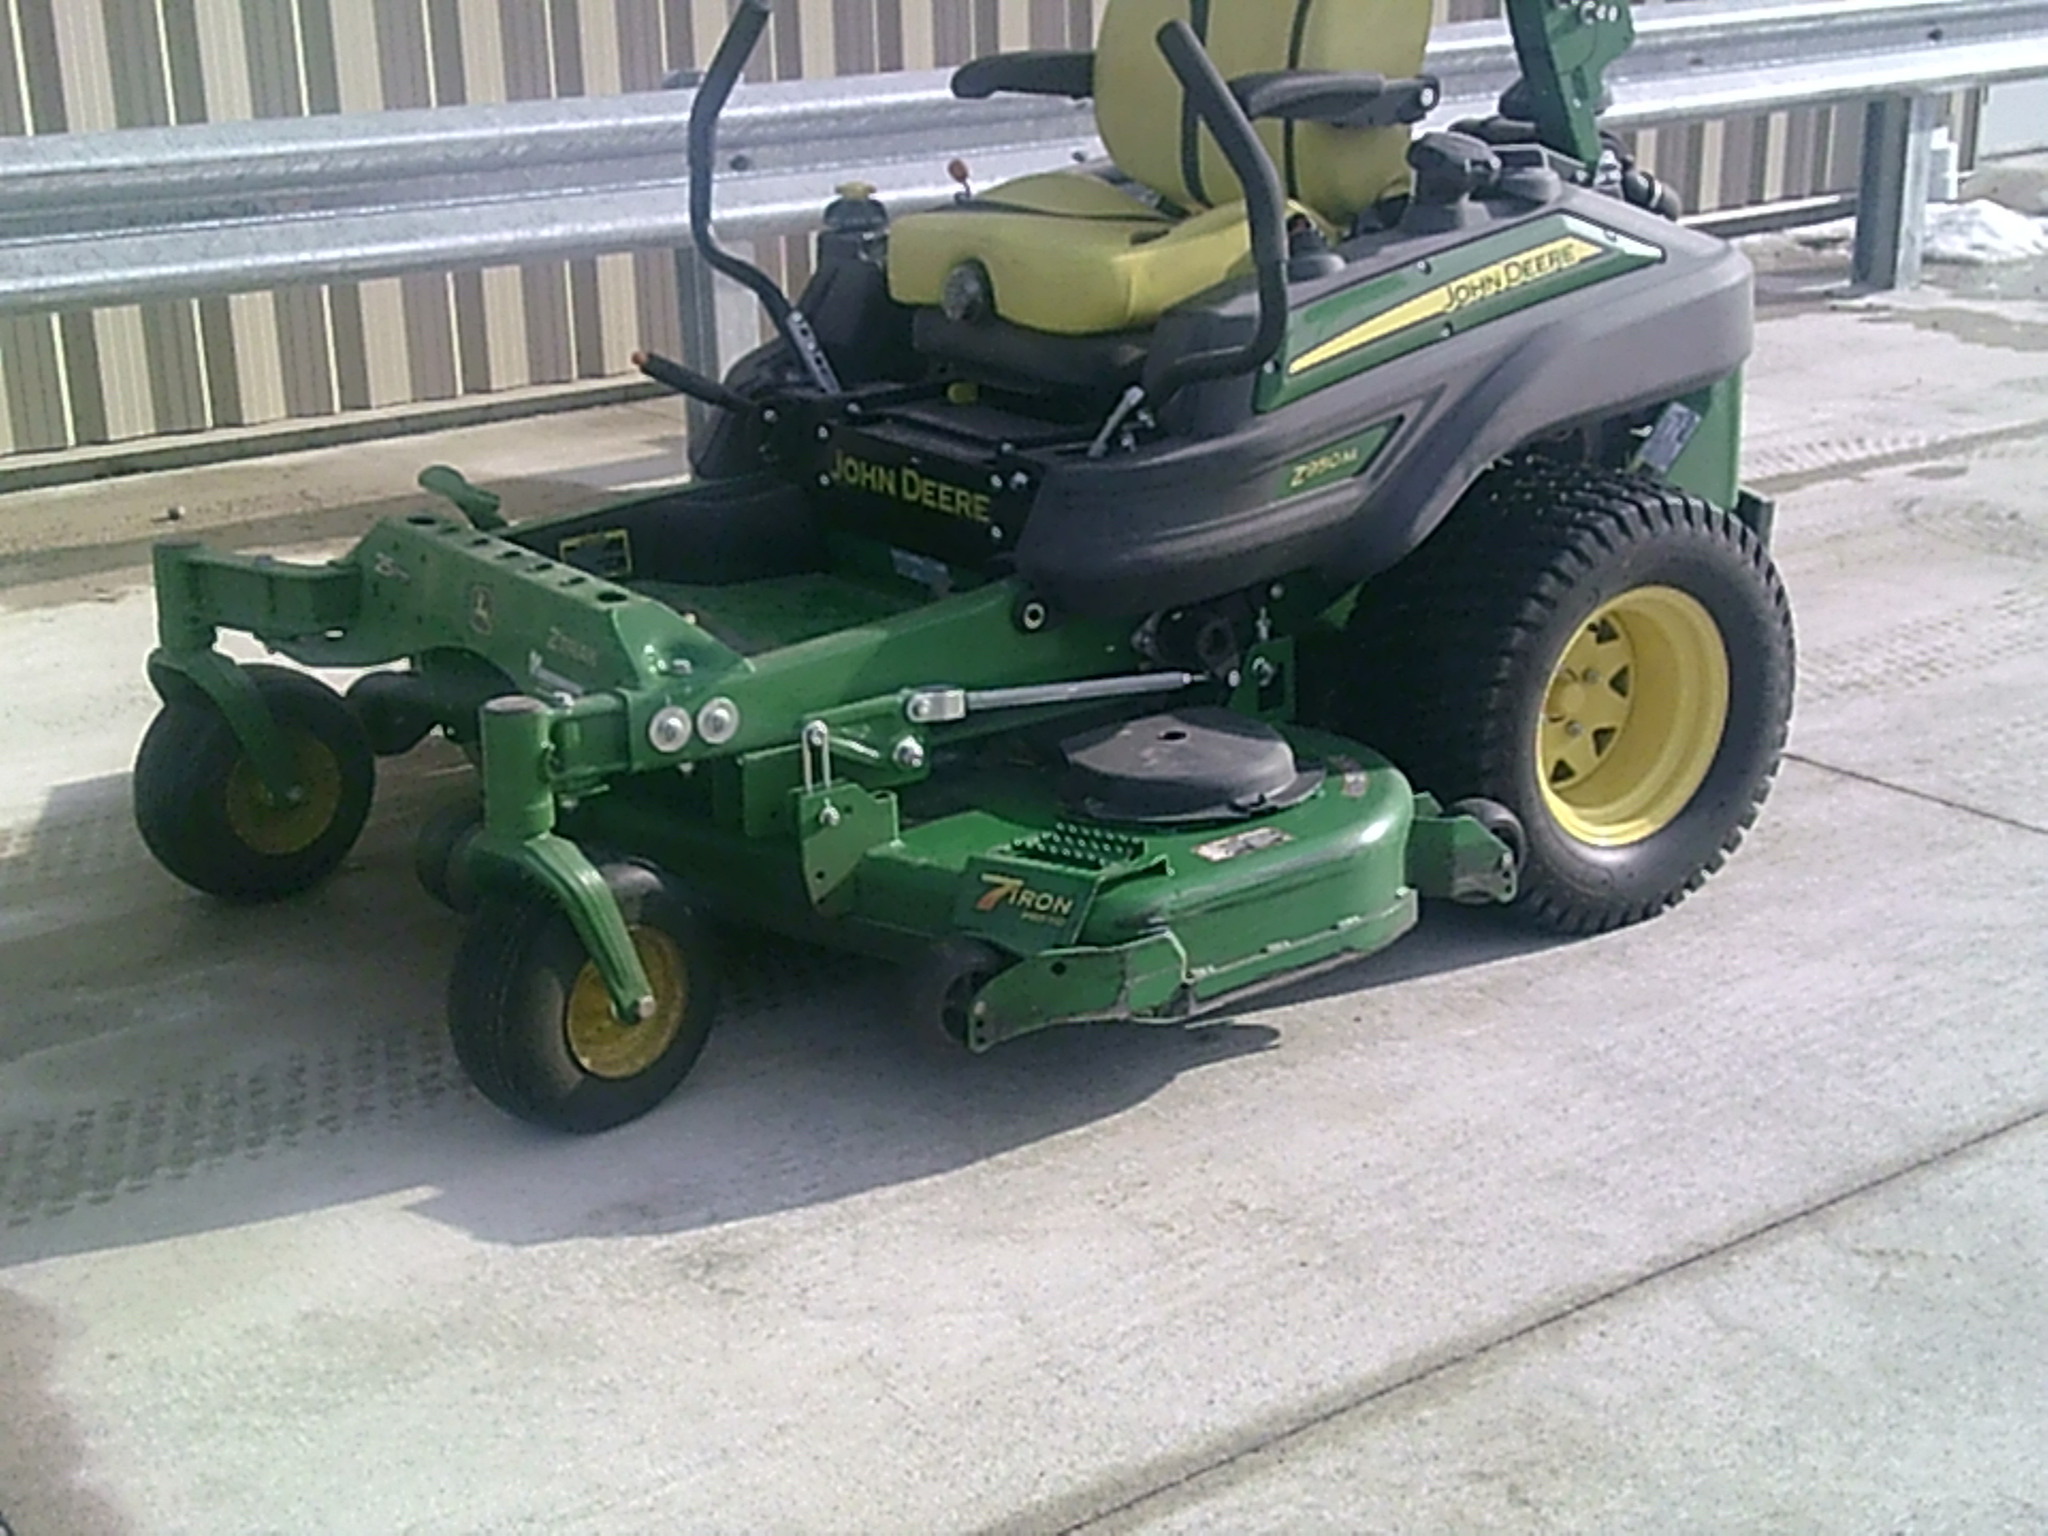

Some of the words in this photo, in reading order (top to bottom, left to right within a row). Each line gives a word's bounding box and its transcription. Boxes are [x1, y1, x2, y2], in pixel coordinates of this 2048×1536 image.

[1443, 270, 1502, 308] JOHN
[1504, 243, 1575, 284] DEERE
[830, 450, 897, 495] JOHN
[901, 467, 992, 522] DEERE
